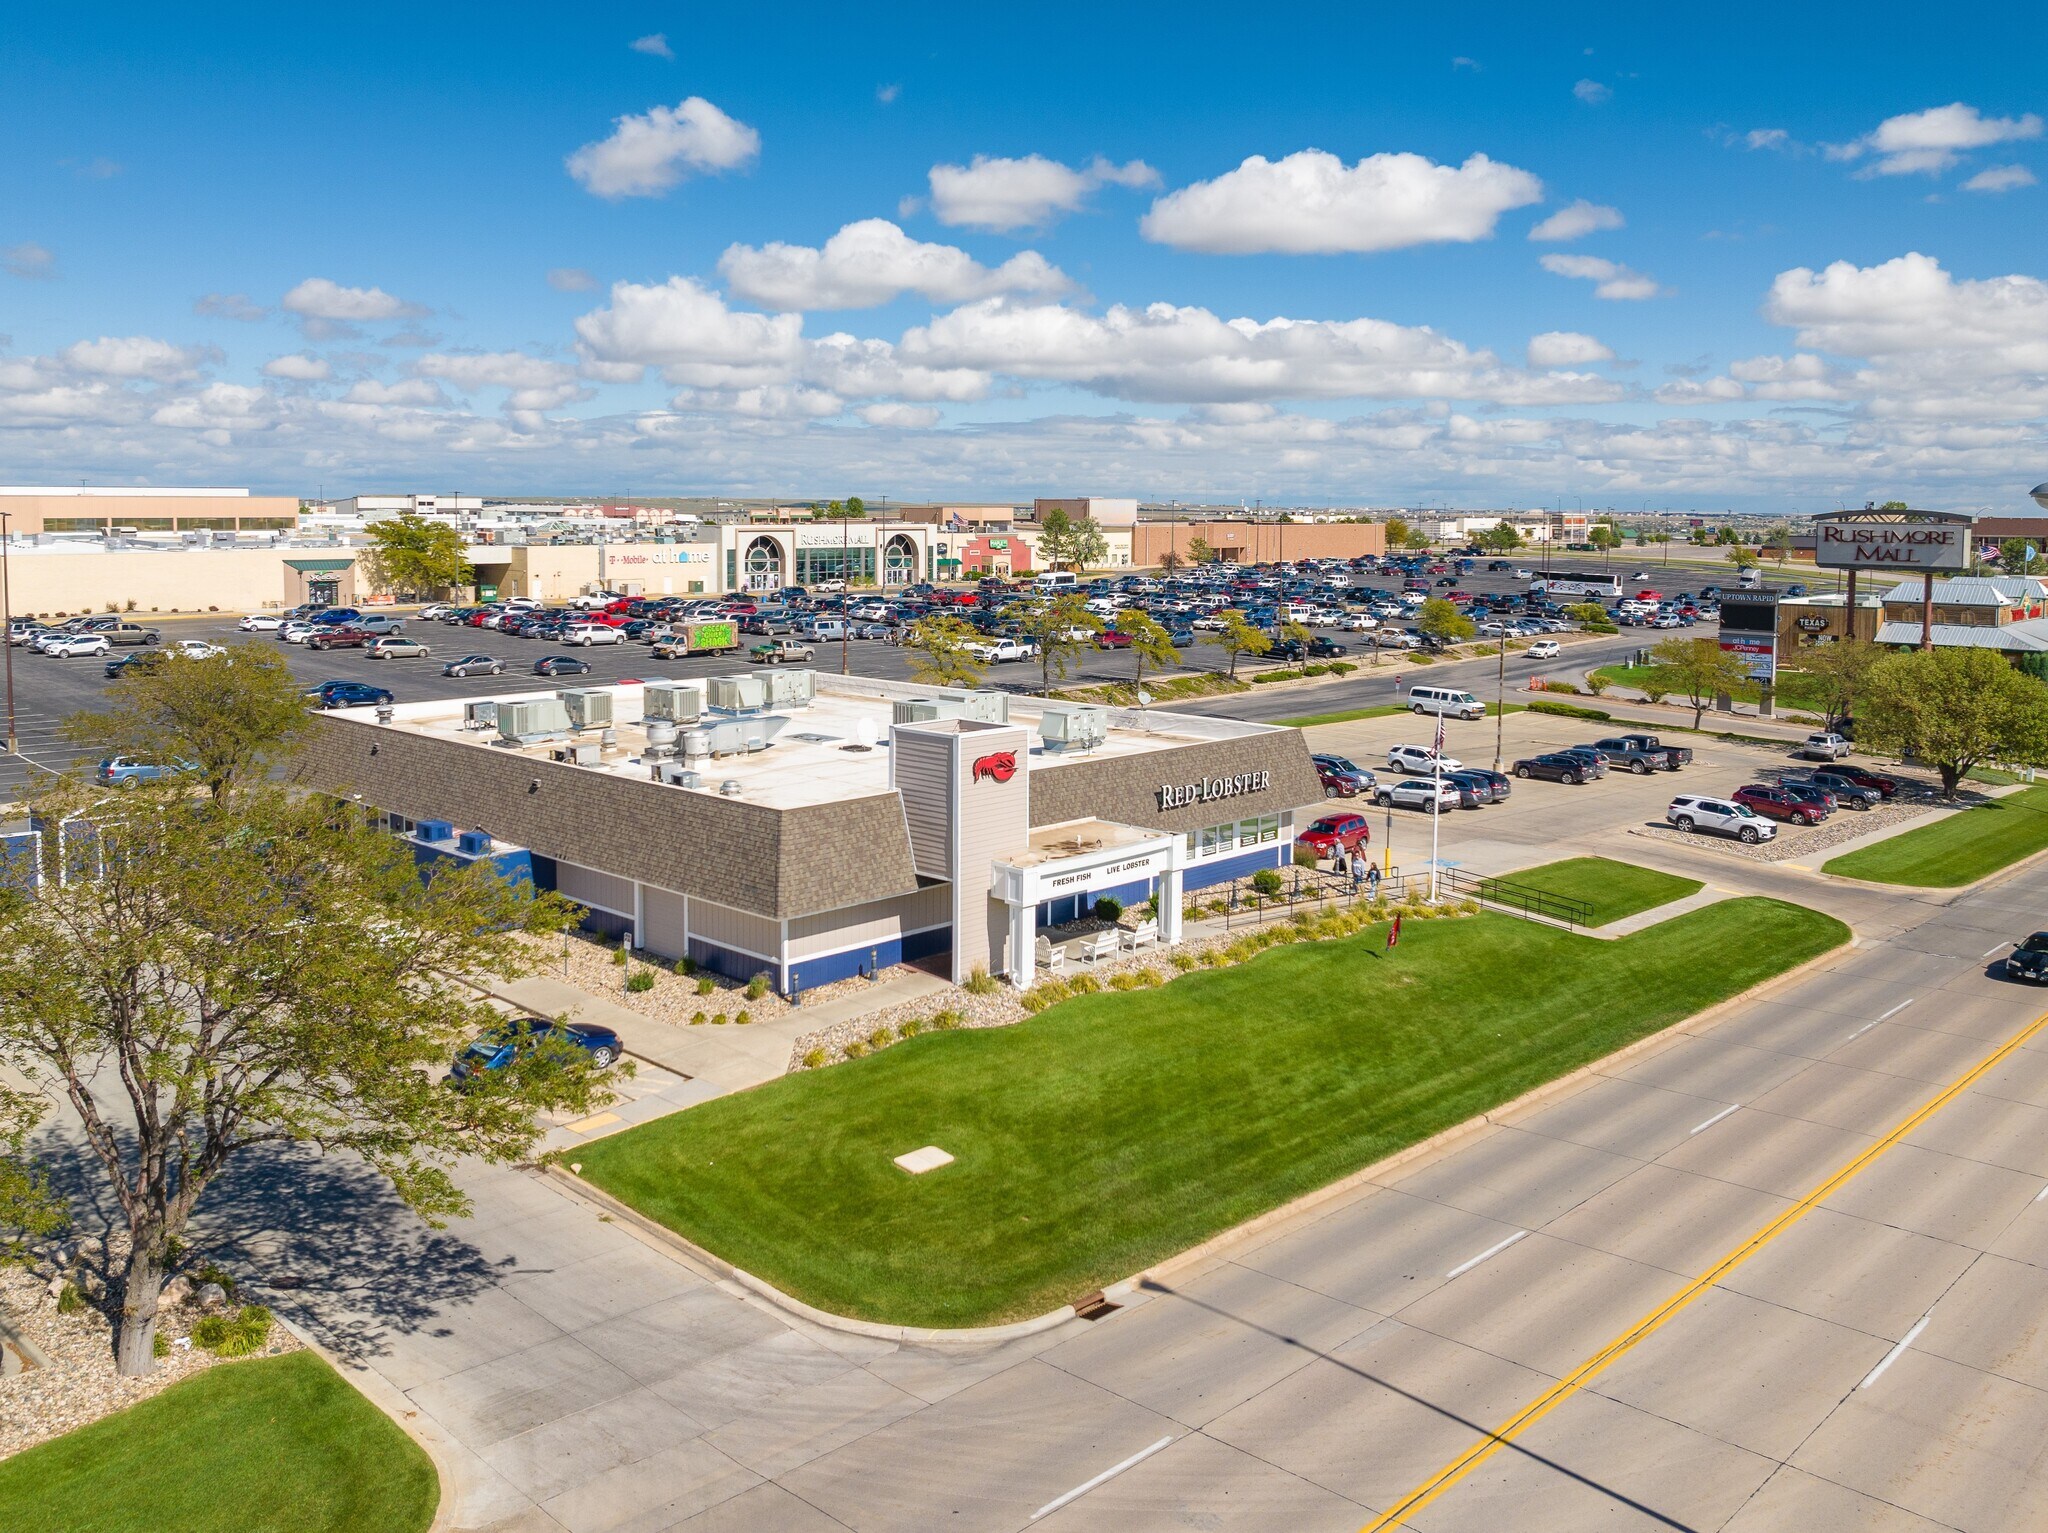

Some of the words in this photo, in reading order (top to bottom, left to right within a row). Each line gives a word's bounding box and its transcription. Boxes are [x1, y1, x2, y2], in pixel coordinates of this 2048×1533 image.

[848, 535, 870, 545] MALL
[1823, 526, 1955, 545] RUSHMORE
[652, 548, 667, 564] at
[1854, 545, 1921, 563] MALL
[1722, 592, 1751, 601] UPTOWN
[1752, 594, 1774, 602] RAPID
[702, 624, 727, 632] GREEN
[1799, 618, 1826, 627] TEXAS
[701, 637, 728, 648] SHACK
[1818, 634, 1832, 642] NOW
[1732, 644, 1760, 653] JCPenney
[1161, 784, 1196, 809] RED
[1202, 770, 1271, 800] LOBSTER
[1106, 865, 1121, 875] LIVE
[1122, 858, 1150, 871] LOBSTER
[1052, 877, 1075, 888] FRESH
[1076, 872, 1092, 882] FISH
